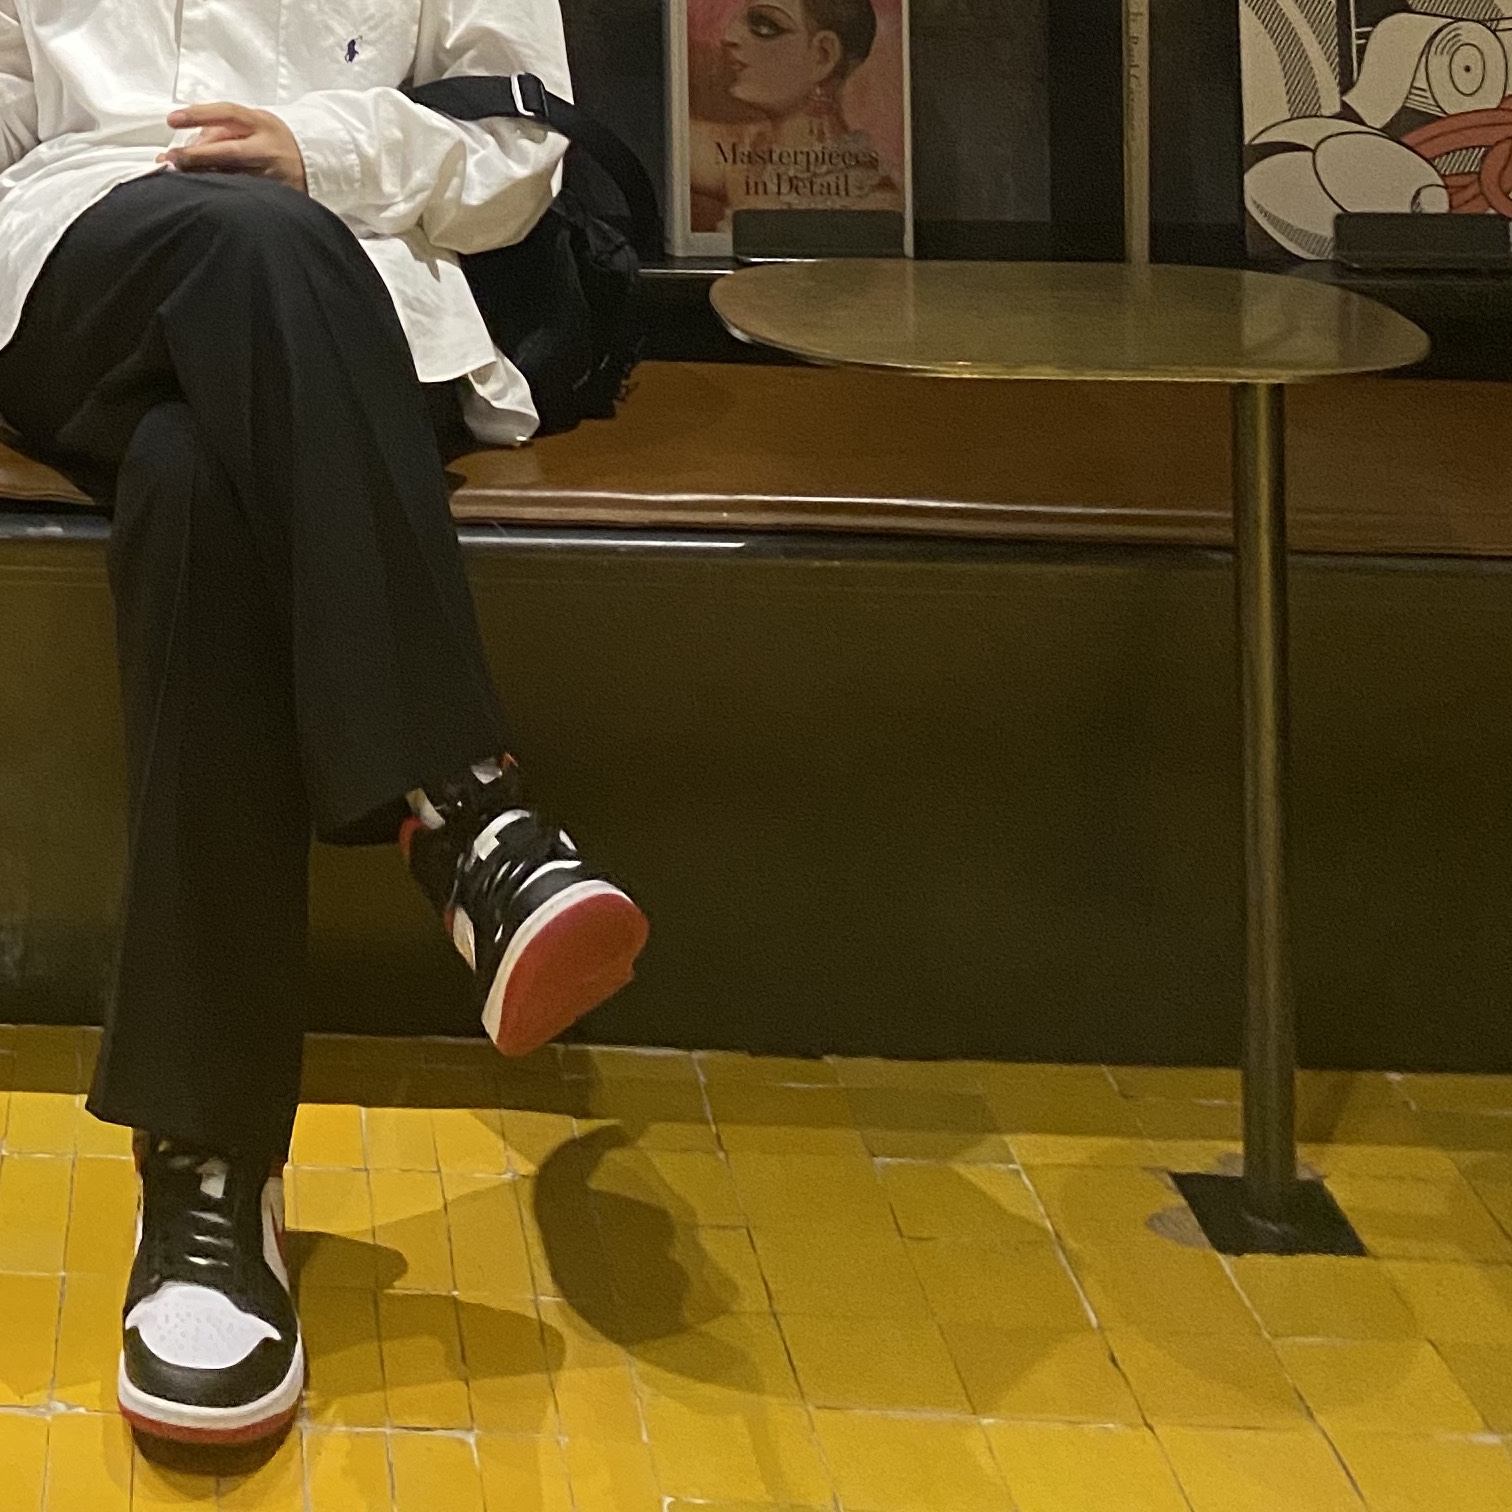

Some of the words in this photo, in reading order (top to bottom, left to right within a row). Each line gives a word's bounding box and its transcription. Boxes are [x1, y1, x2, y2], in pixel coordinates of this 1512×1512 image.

[716, 141, 879, 175] Masterpieces
[745, 175, 763, 197] in
[776, 173, 850, 197] Detail
